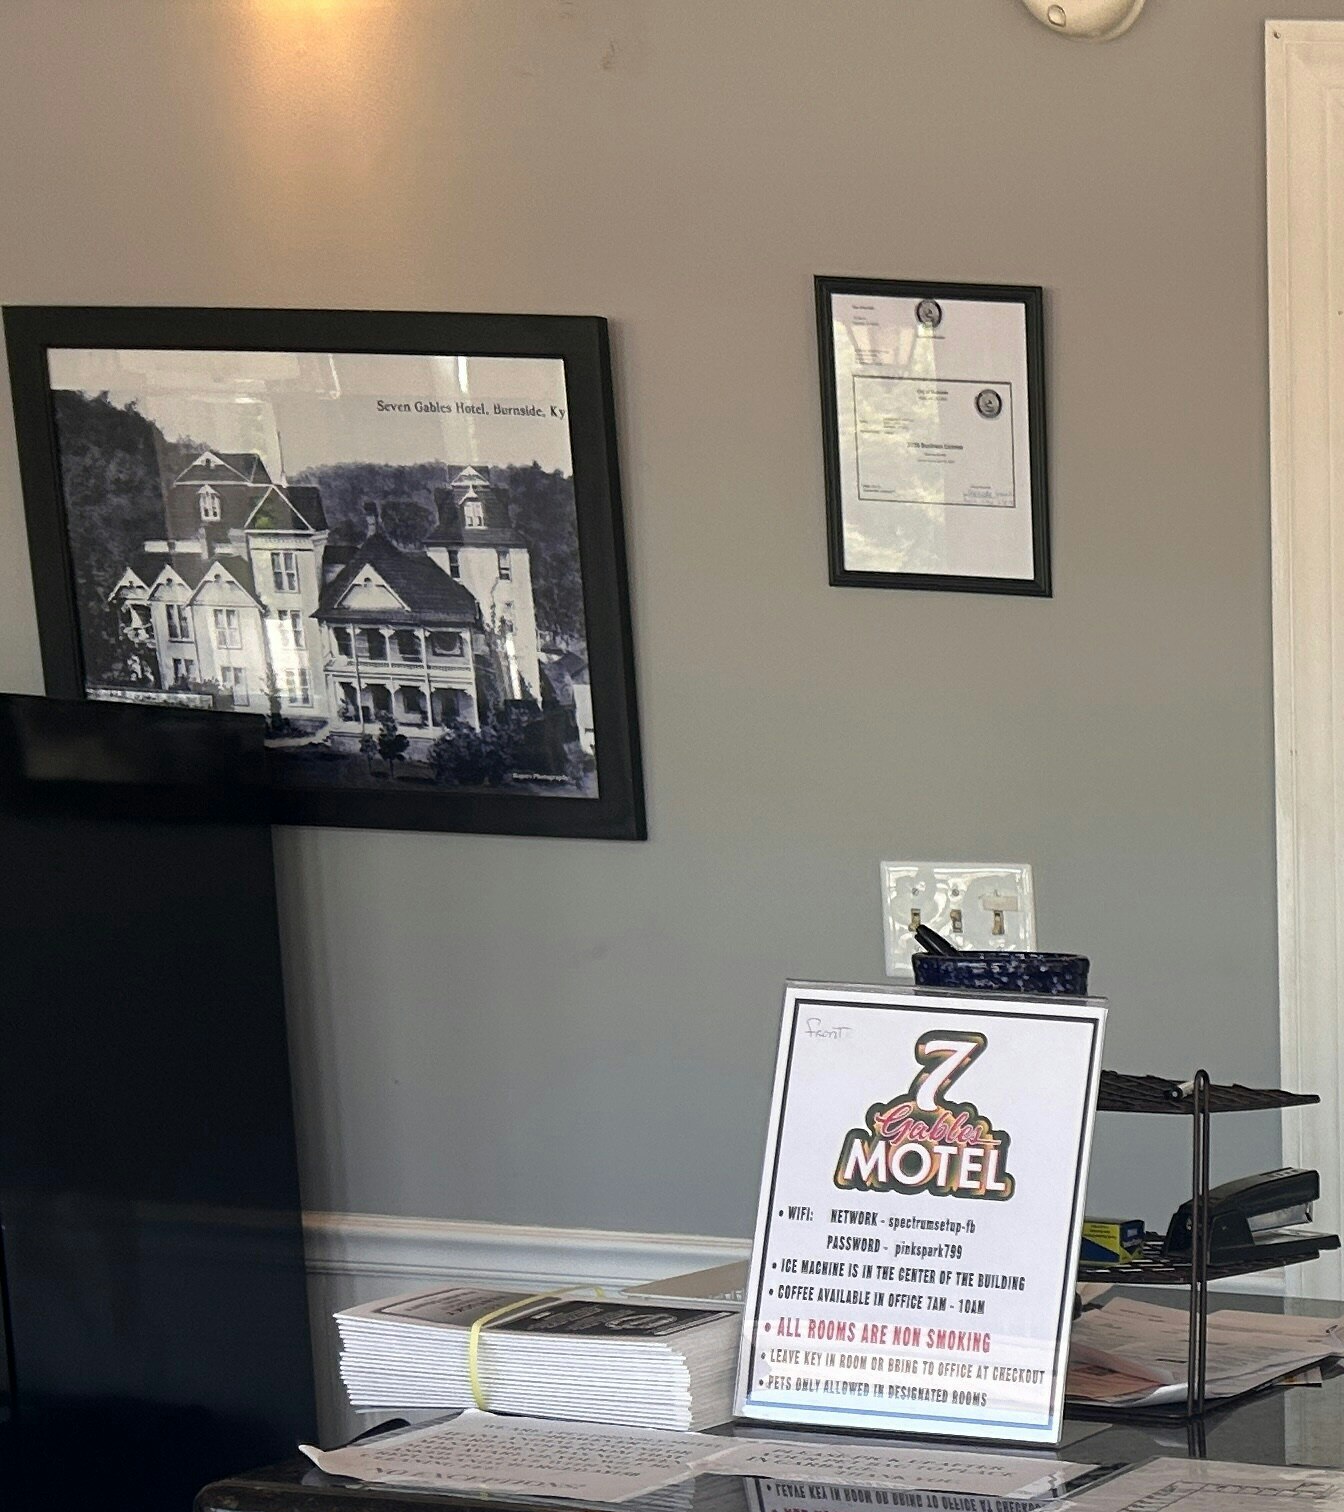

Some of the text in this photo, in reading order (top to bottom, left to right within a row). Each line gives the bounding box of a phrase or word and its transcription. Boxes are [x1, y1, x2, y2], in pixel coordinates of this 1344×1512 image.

[377, 400, 411, 412] Seven
[415, 401, 451, 414] Gables
[550, 406, 566, 420] Ky
[916, 1039, 979, 1112] 7
[874, 1104, 1002, 1145] Gables
[843, 1139, 1005, 1191] MOTEL
[788, 1206, 976, 1235] WIFI: NETWORK spectrumsetup-fb
[826, 1235, 963, 1260] PASSWORD pinkspark799
[781, 1258, 1026, 1291] ICE MACHINE IS IN THE CENTER OF THE BUILDING
[777, 1284, 985, 1314] COFFEE AVAILABLE IN OFFICE 7AM 10AM
[777, 1316, 991, 1353] ALL ROOMS ARE NON SMOKING
[770, 1348, 1045, 1385] LEAVE KEY IN ROOM OR BRING TO OFFICE AT CHECKOUT
[767, 1375, 987, 1407] PETS ONLY ALLOWED IN DESIGNATED ROOMS
